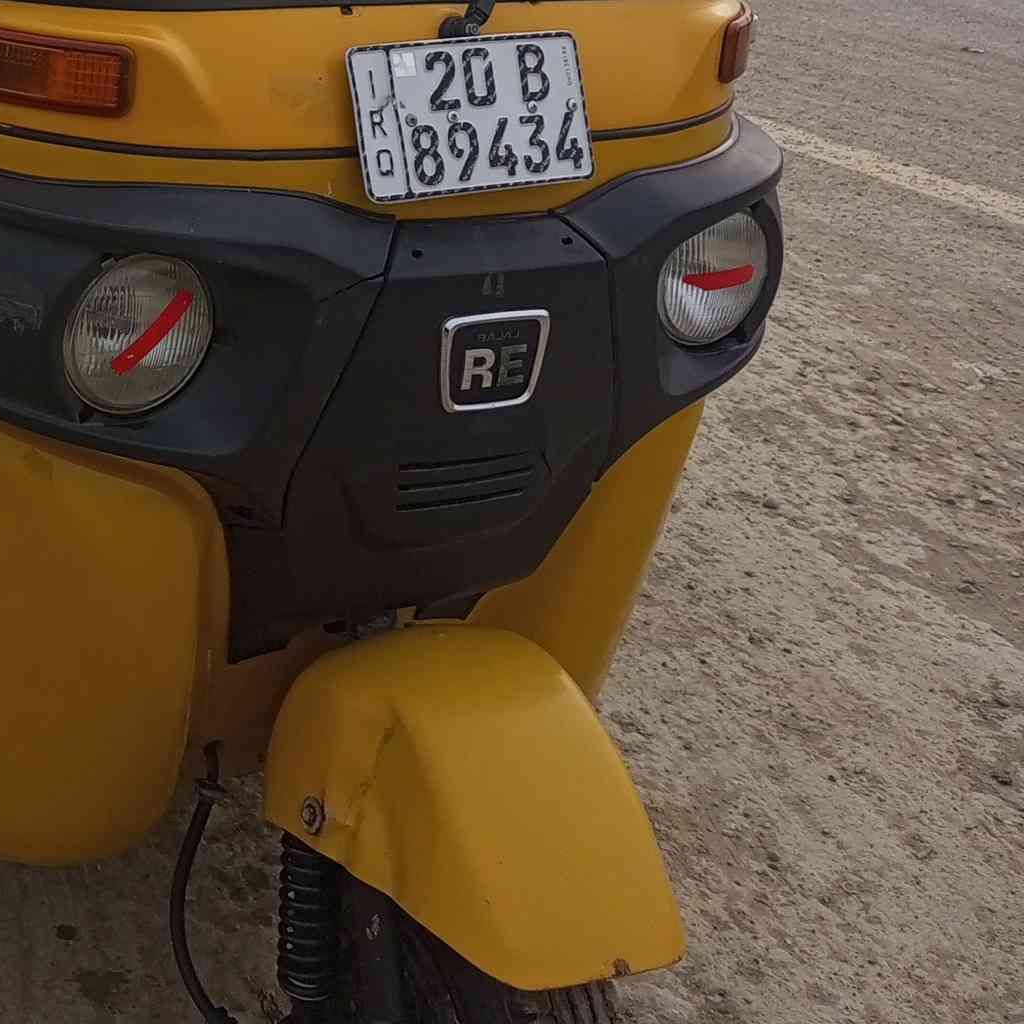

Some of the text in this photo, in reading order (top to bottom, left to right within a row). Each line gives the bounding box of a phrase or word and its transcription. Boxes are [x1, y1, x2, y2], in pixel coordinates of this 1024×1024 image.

[425, 47, 497, 111] 20
[516, 43, 550, 103] B
[368, 69, 395, 177] IRQ
[410, 111, 584, 186] 89434
[460, 344, 528, 391] RE
